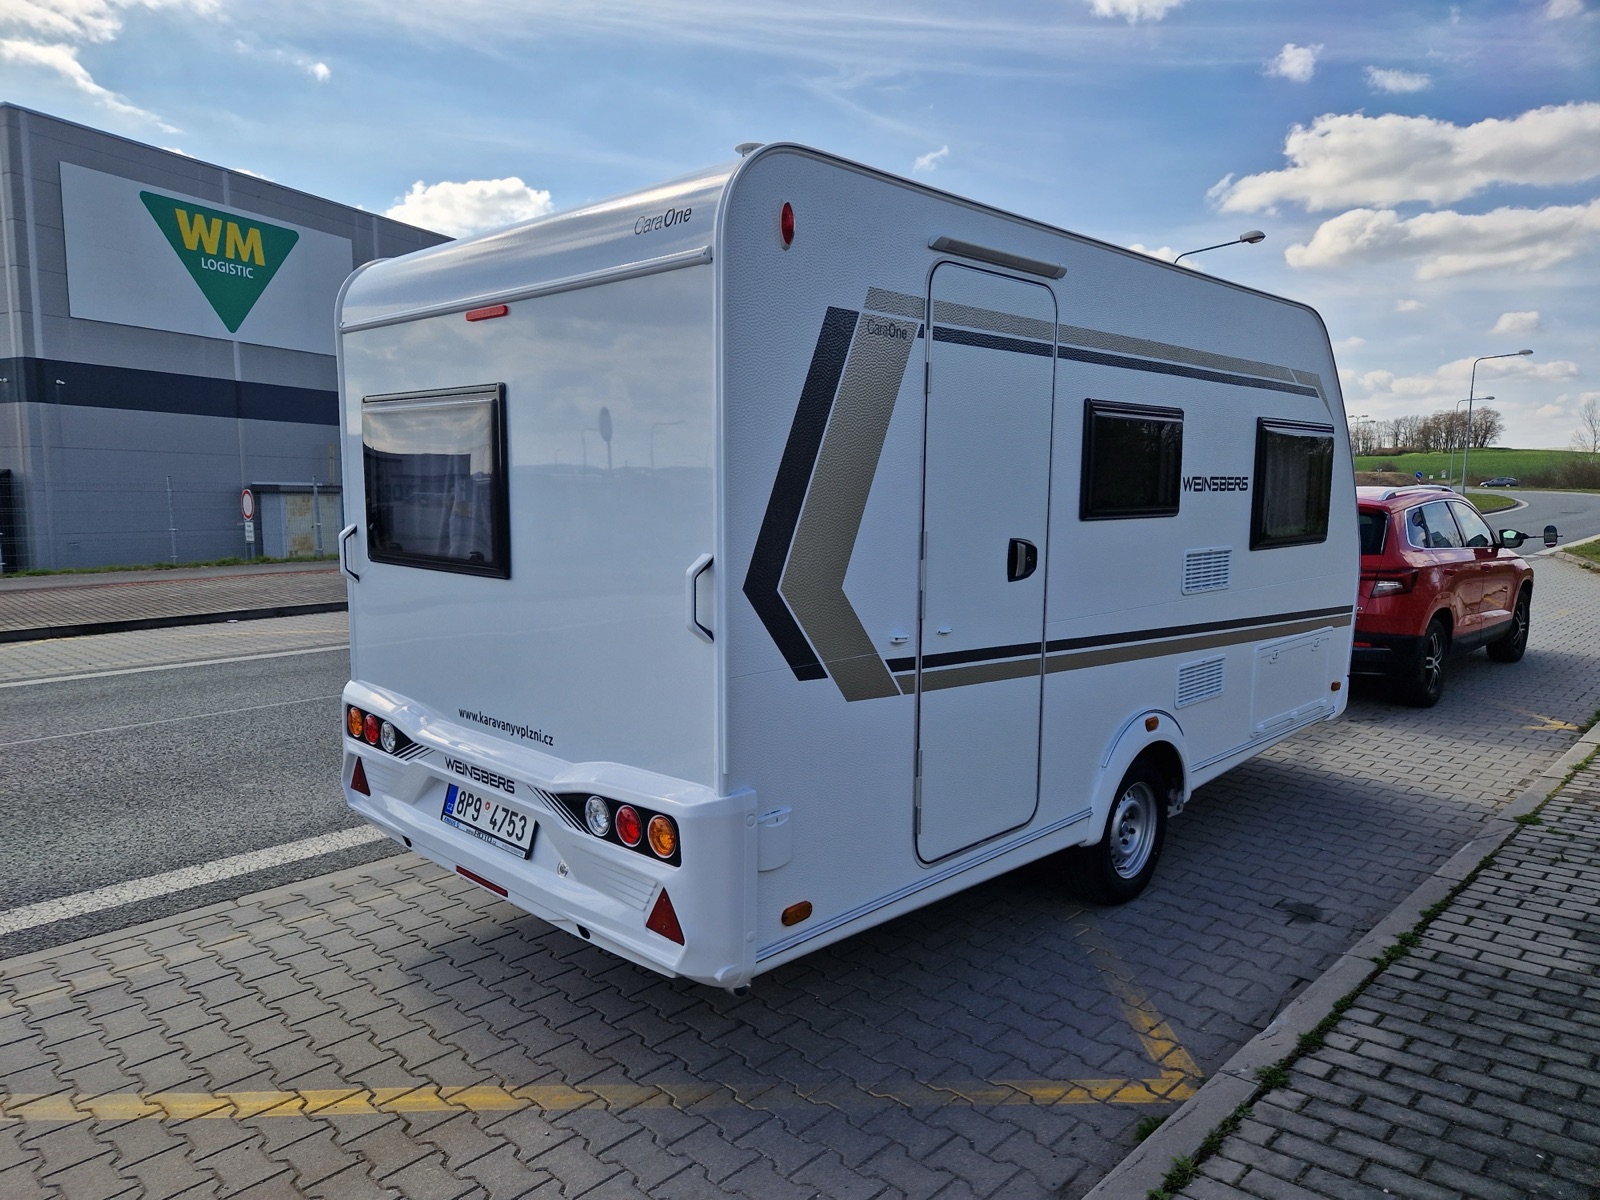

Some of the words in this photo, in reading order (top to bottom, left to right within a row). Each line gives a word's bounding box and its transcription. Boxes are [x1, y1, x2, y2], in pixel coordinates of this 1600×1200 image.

[634, 207, 692, 235] CaraOne
[174, 208, 266, 267] WM
[201, 257, 254, 279] LOGISTIC
[868, 319, 908, 340] CaraOne
[1182, 476, 1249, 492] WEINSBERG
[458, 708, 554, 747] www.karavanyvplzni.cz
[444, 756, 515, 795] WEINSBERG
[446, 802, 454, 811] CZ
[456, 790, 483, 822] 8P9
[489, 804, 527, 842] 4753
